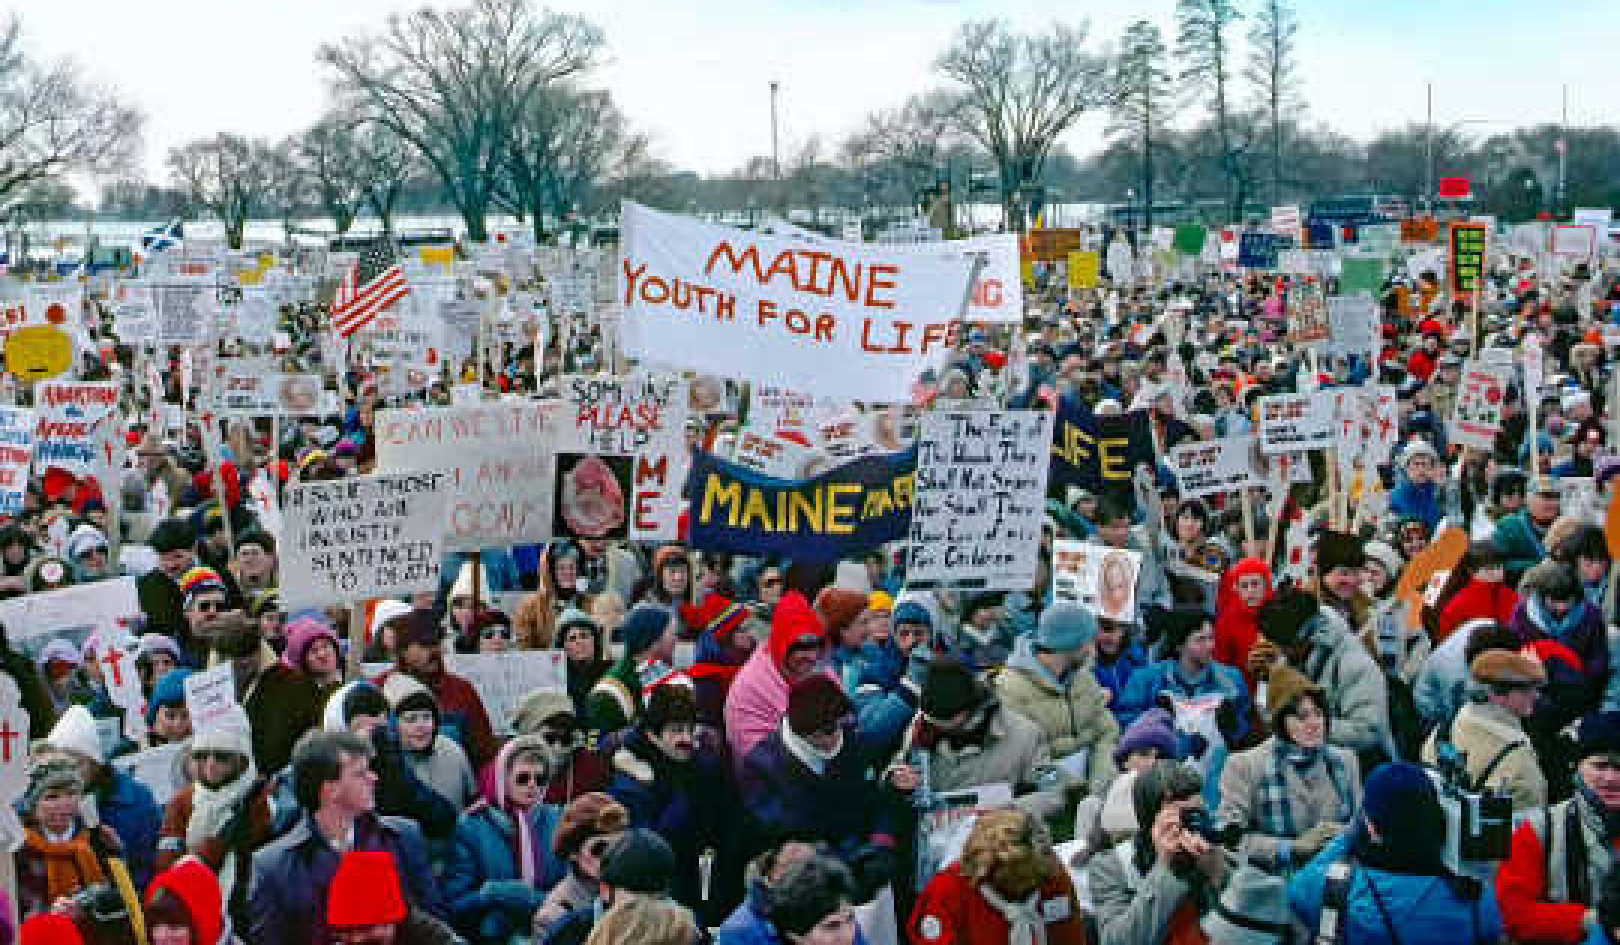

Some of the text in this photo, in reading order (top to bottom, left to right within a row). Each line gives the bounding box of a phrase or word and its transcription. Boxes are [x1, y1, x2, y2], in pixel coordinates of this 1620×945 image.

[704, 240, 899, 308] MAINE
[622, 257, 736, 322] YOUTH
[757, 300, 836, 341] FOR
[576, 399, 662, 430] PLEASE
[947, 412, 981, 437] The
[375, 474, 445, 496] THOSE
[916, 466, 956, 491] Shall
[310, 502, 364, 525] WHO
[698, 473, 864, 534] MAINE
[942, 492, 985, 513] Shall
[329, 562, 440, 591] TO DEATH
